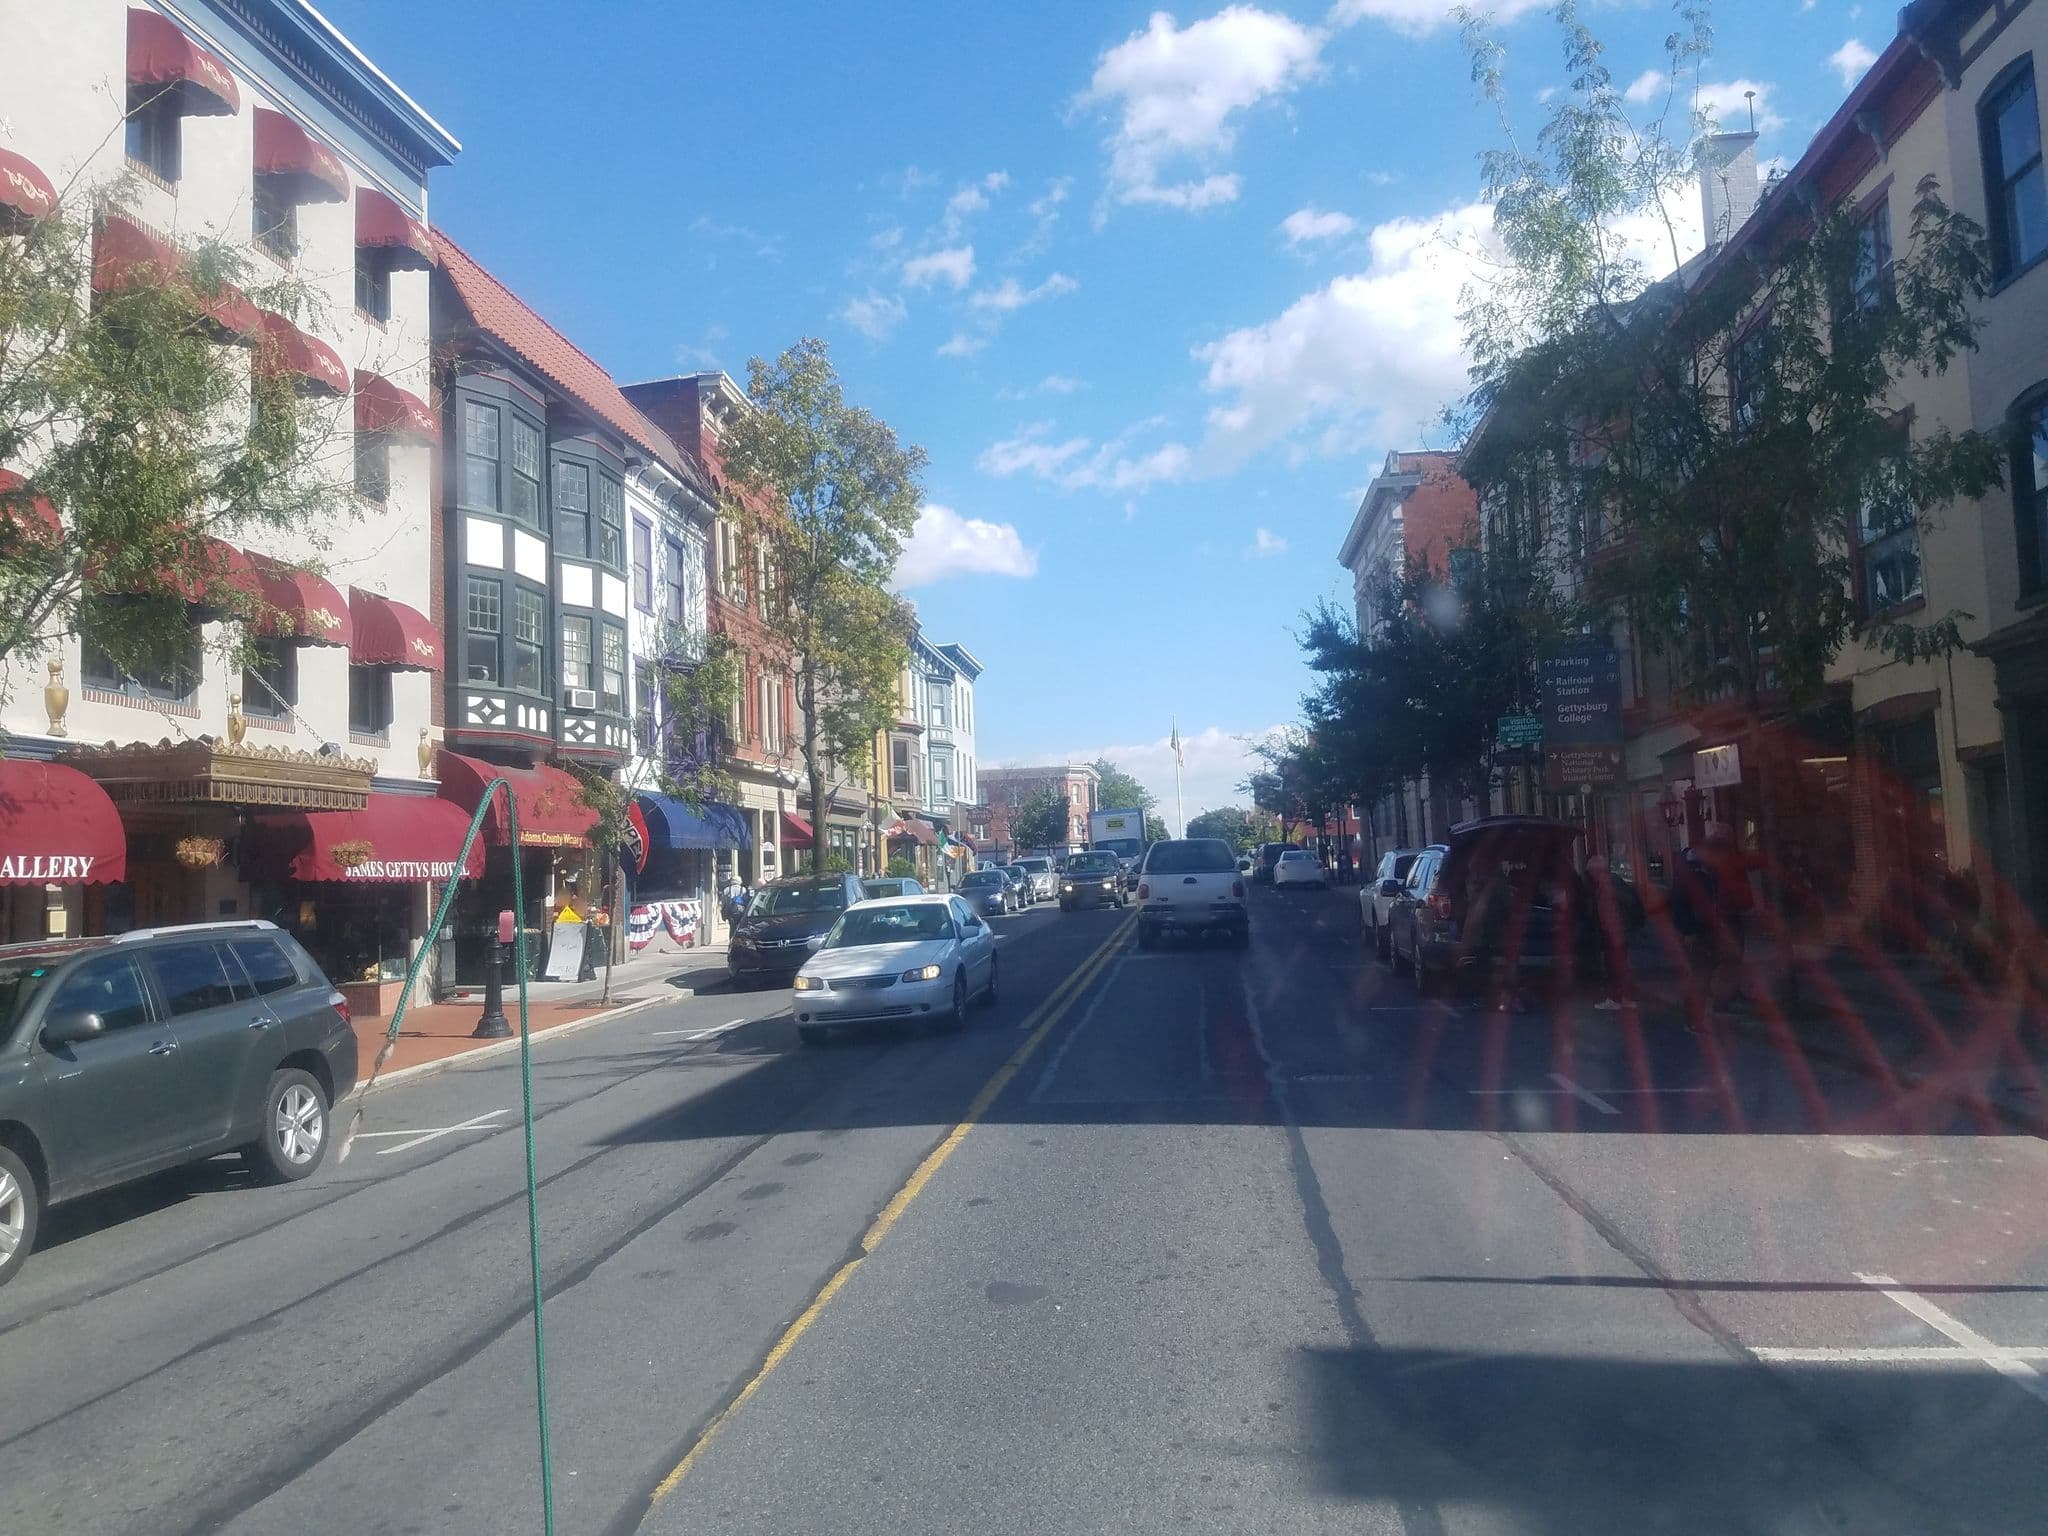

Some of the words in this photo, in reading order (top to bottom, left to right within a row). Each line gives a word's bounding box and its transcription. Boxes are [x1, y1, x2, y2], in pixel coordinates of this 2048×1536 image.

[1555, 656, 1589, 667] Parking
[1556, 675, 1594, 686] Railroad
[1556, 687, 1590, 696] Station
[1557, 702, 1608, 714] Gettysburg
[1557, 713, 1592, 724] College
[520, 831, 542, 843] Adams
[542, 832, 563, 846] County
[563, 833, 583, 847] Winery
[0, 855, 95, 879] ALLERY
[345, 861, 385, 878] JAMES
[385, 861, 429, 878] GETTYS
[431, 861, 470, 877] HOTL
